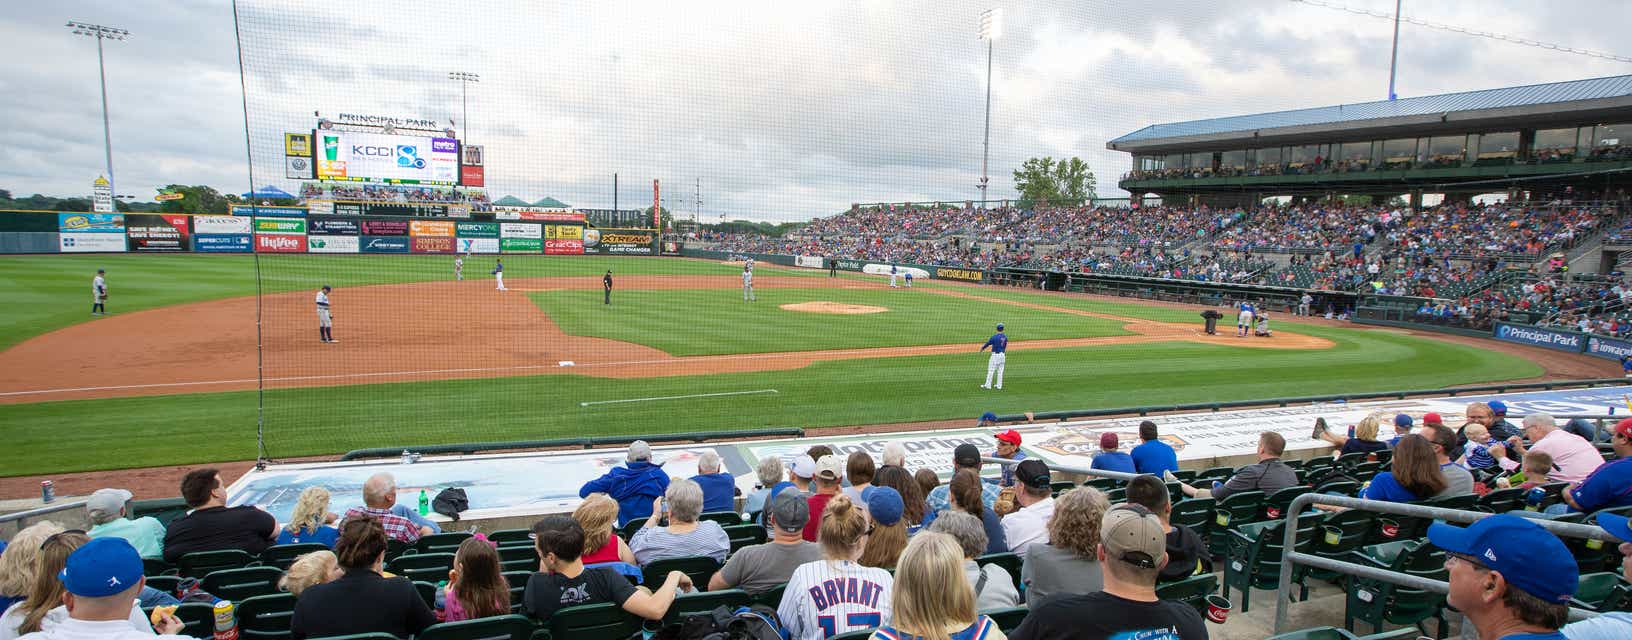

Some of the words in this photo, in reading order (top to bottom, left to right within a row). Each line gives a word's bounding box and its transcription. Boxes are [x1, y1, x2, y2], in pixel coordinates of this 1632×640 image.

[339, 112, 402, 125] PRINCIPAL
[406, 118, 437, 128] PARK
[352, 145, 393, 156] KCCI
[259, 222, 300, 230] SUBWAY
[566, 241, 584, 249] Clips
[601, 234, 653, 244] XTREAM
[1510, 327, 1551, 343] Principal
[1554, 334, 1578, 346] Park
[1599, 341, 1632, 357] iowacu
[809, 577, 883, 612] BRYANT
